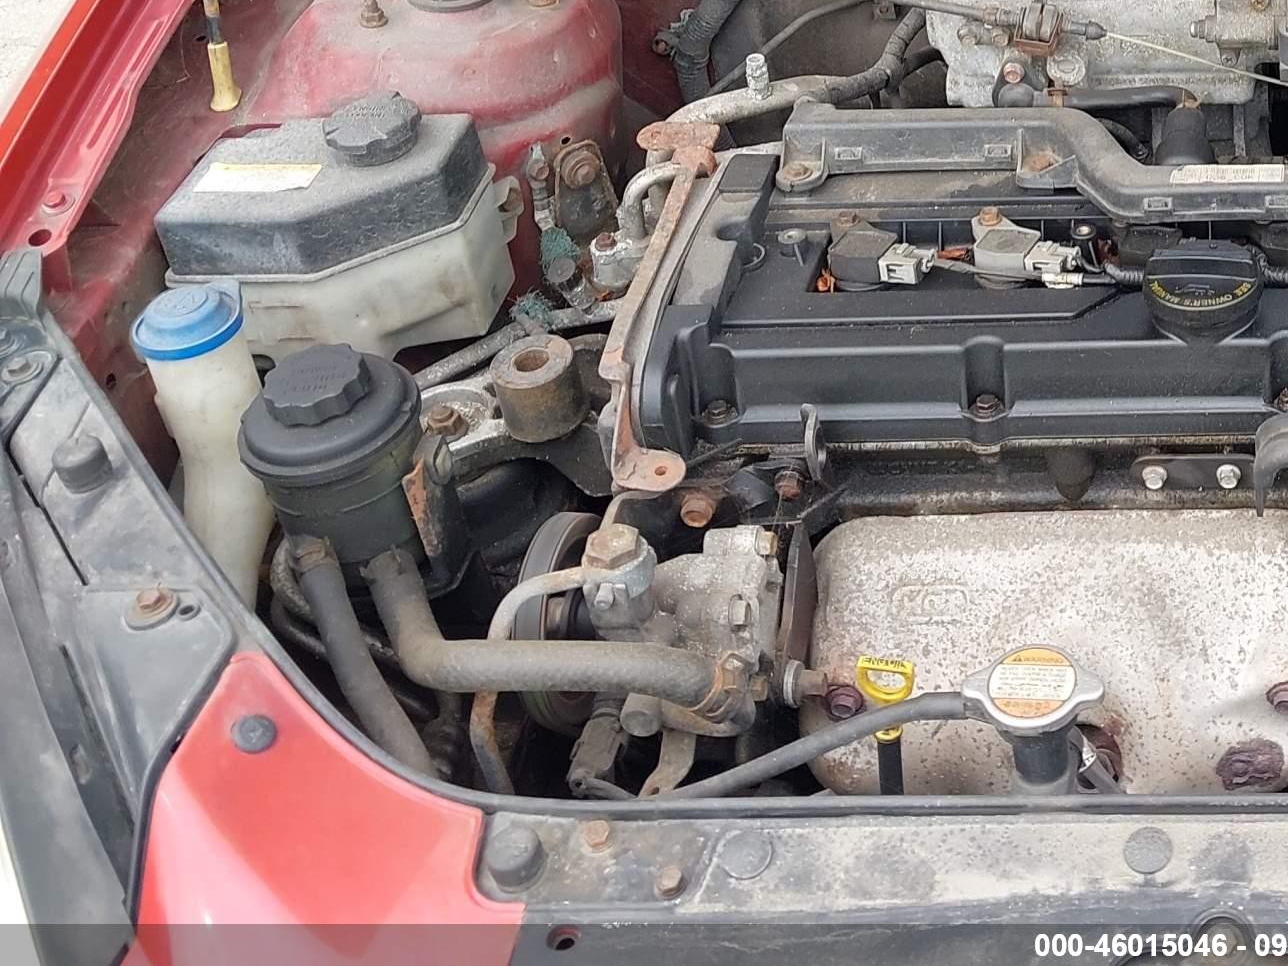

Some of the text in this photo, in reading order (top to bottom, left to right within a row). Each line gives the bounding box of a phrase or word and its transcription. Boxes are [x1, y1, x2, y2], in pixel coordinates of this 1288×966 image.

[1149, 280, 1252, 307] SEE OWNER'S MANUAL
